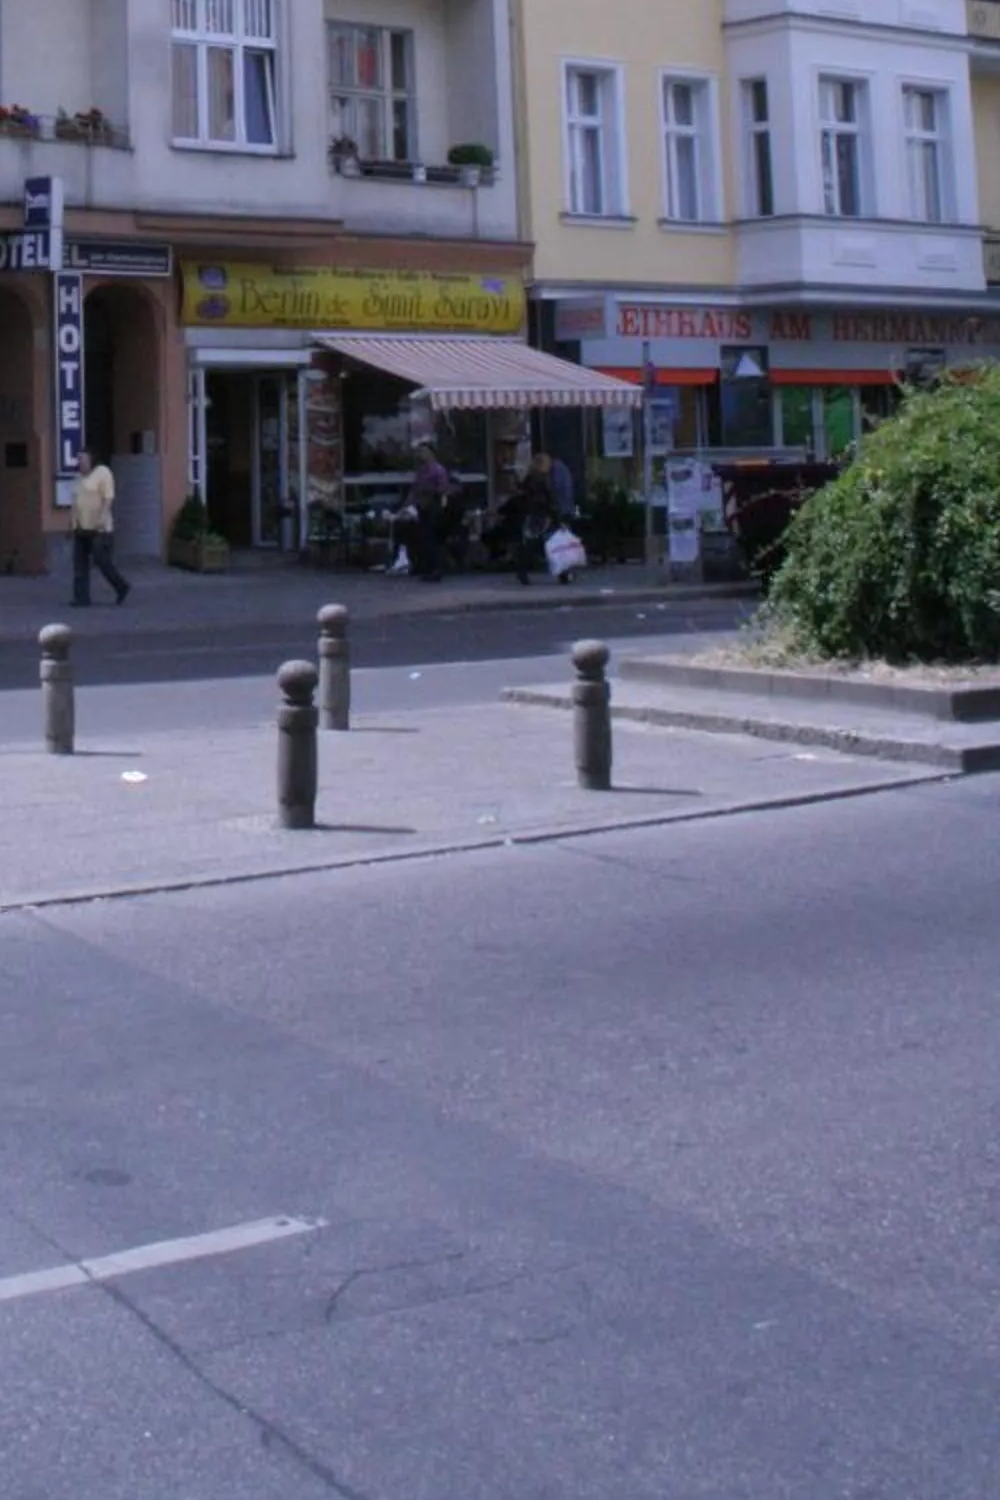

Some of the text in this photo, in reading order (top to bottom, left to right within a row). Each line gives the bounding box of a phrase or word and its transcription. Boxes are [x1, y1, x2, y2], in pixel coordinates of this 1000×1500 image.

[58, 286, 80, 467] HOTEL
[616, 306, 752, 338] EIHHAUS
[769, 310, 811, 341] AM
